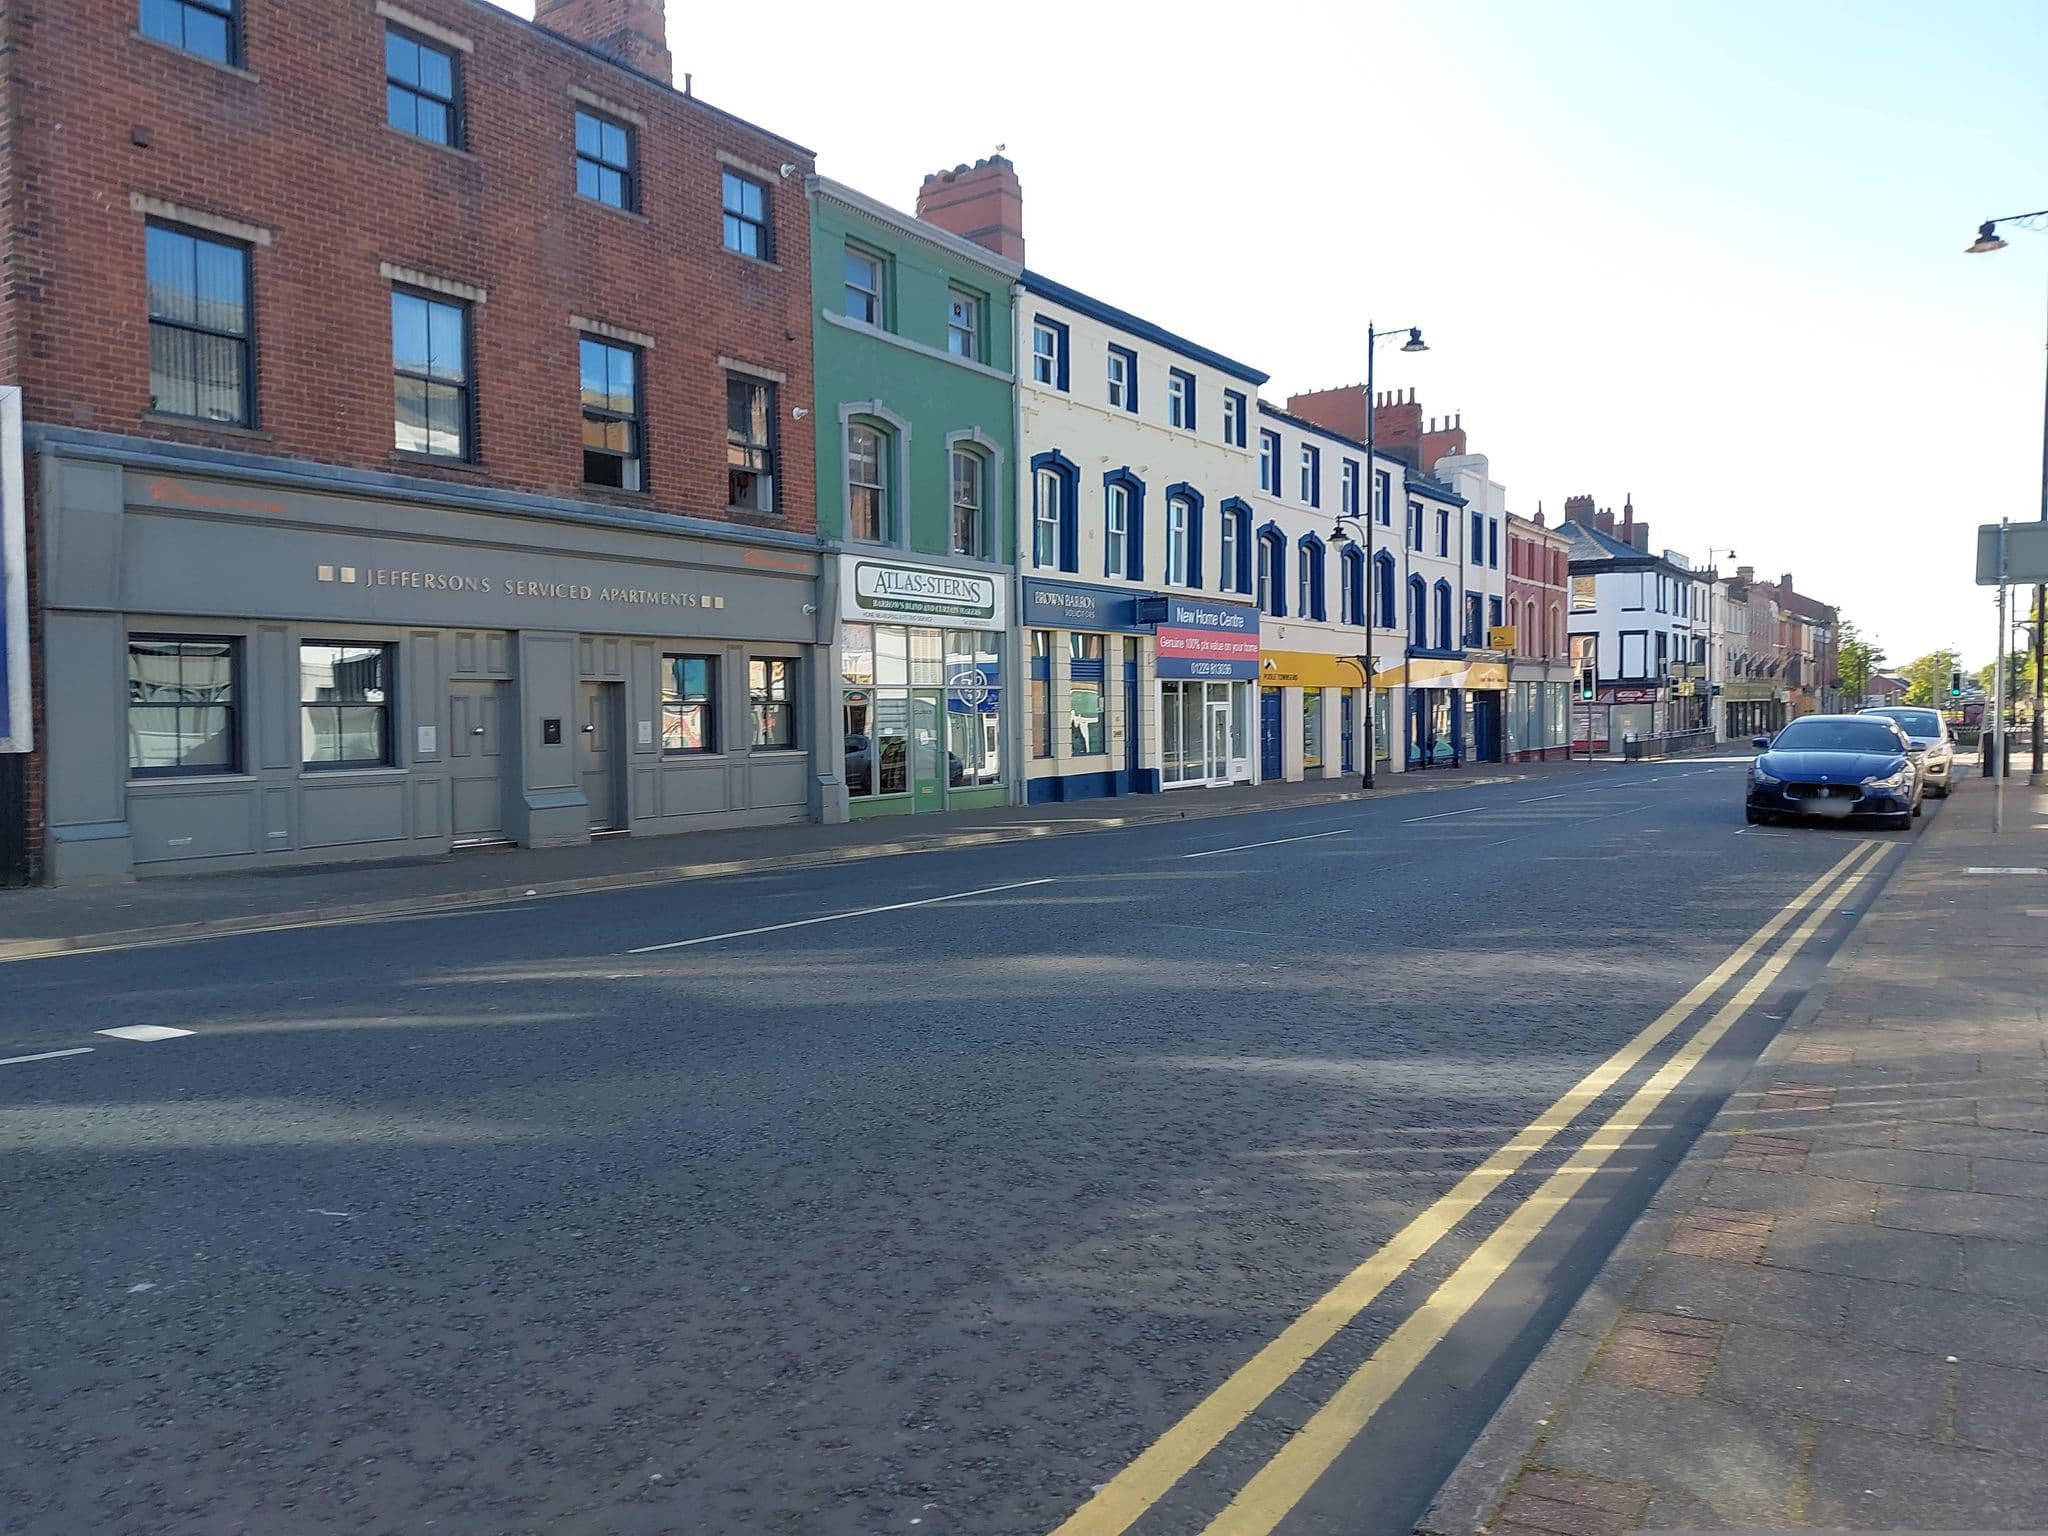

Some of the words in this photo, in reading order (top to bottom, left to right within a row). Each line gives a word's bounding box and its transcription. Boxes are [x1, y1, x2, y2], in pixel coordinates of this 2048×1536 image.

[366, 569, 491, 593] JEFFERSONS
[504, 579, 592, 601] SERVICED
[599, 587, 696, 608] APARTMENTS
[873, 570, 981, 604] ATLAS-STERNS
[1034, 591, 1064, 606] BROWN
[1064, 608, 1096, 619] SOLICITORS
[1176, 606, 1195, 624] New
[1195, 608, 1219, 626] Home
[1219, 611, 1245, 628] Centre
[1159, 636, 1185, 649] Genuine
[1185, 638, 1200, 650] 100%
[1210, 641, 1224, 651] value
[1224, 643, 1232, 652] on
[1232, 643, 1243, 654] your
[1243, 643, 1259, 653] home
